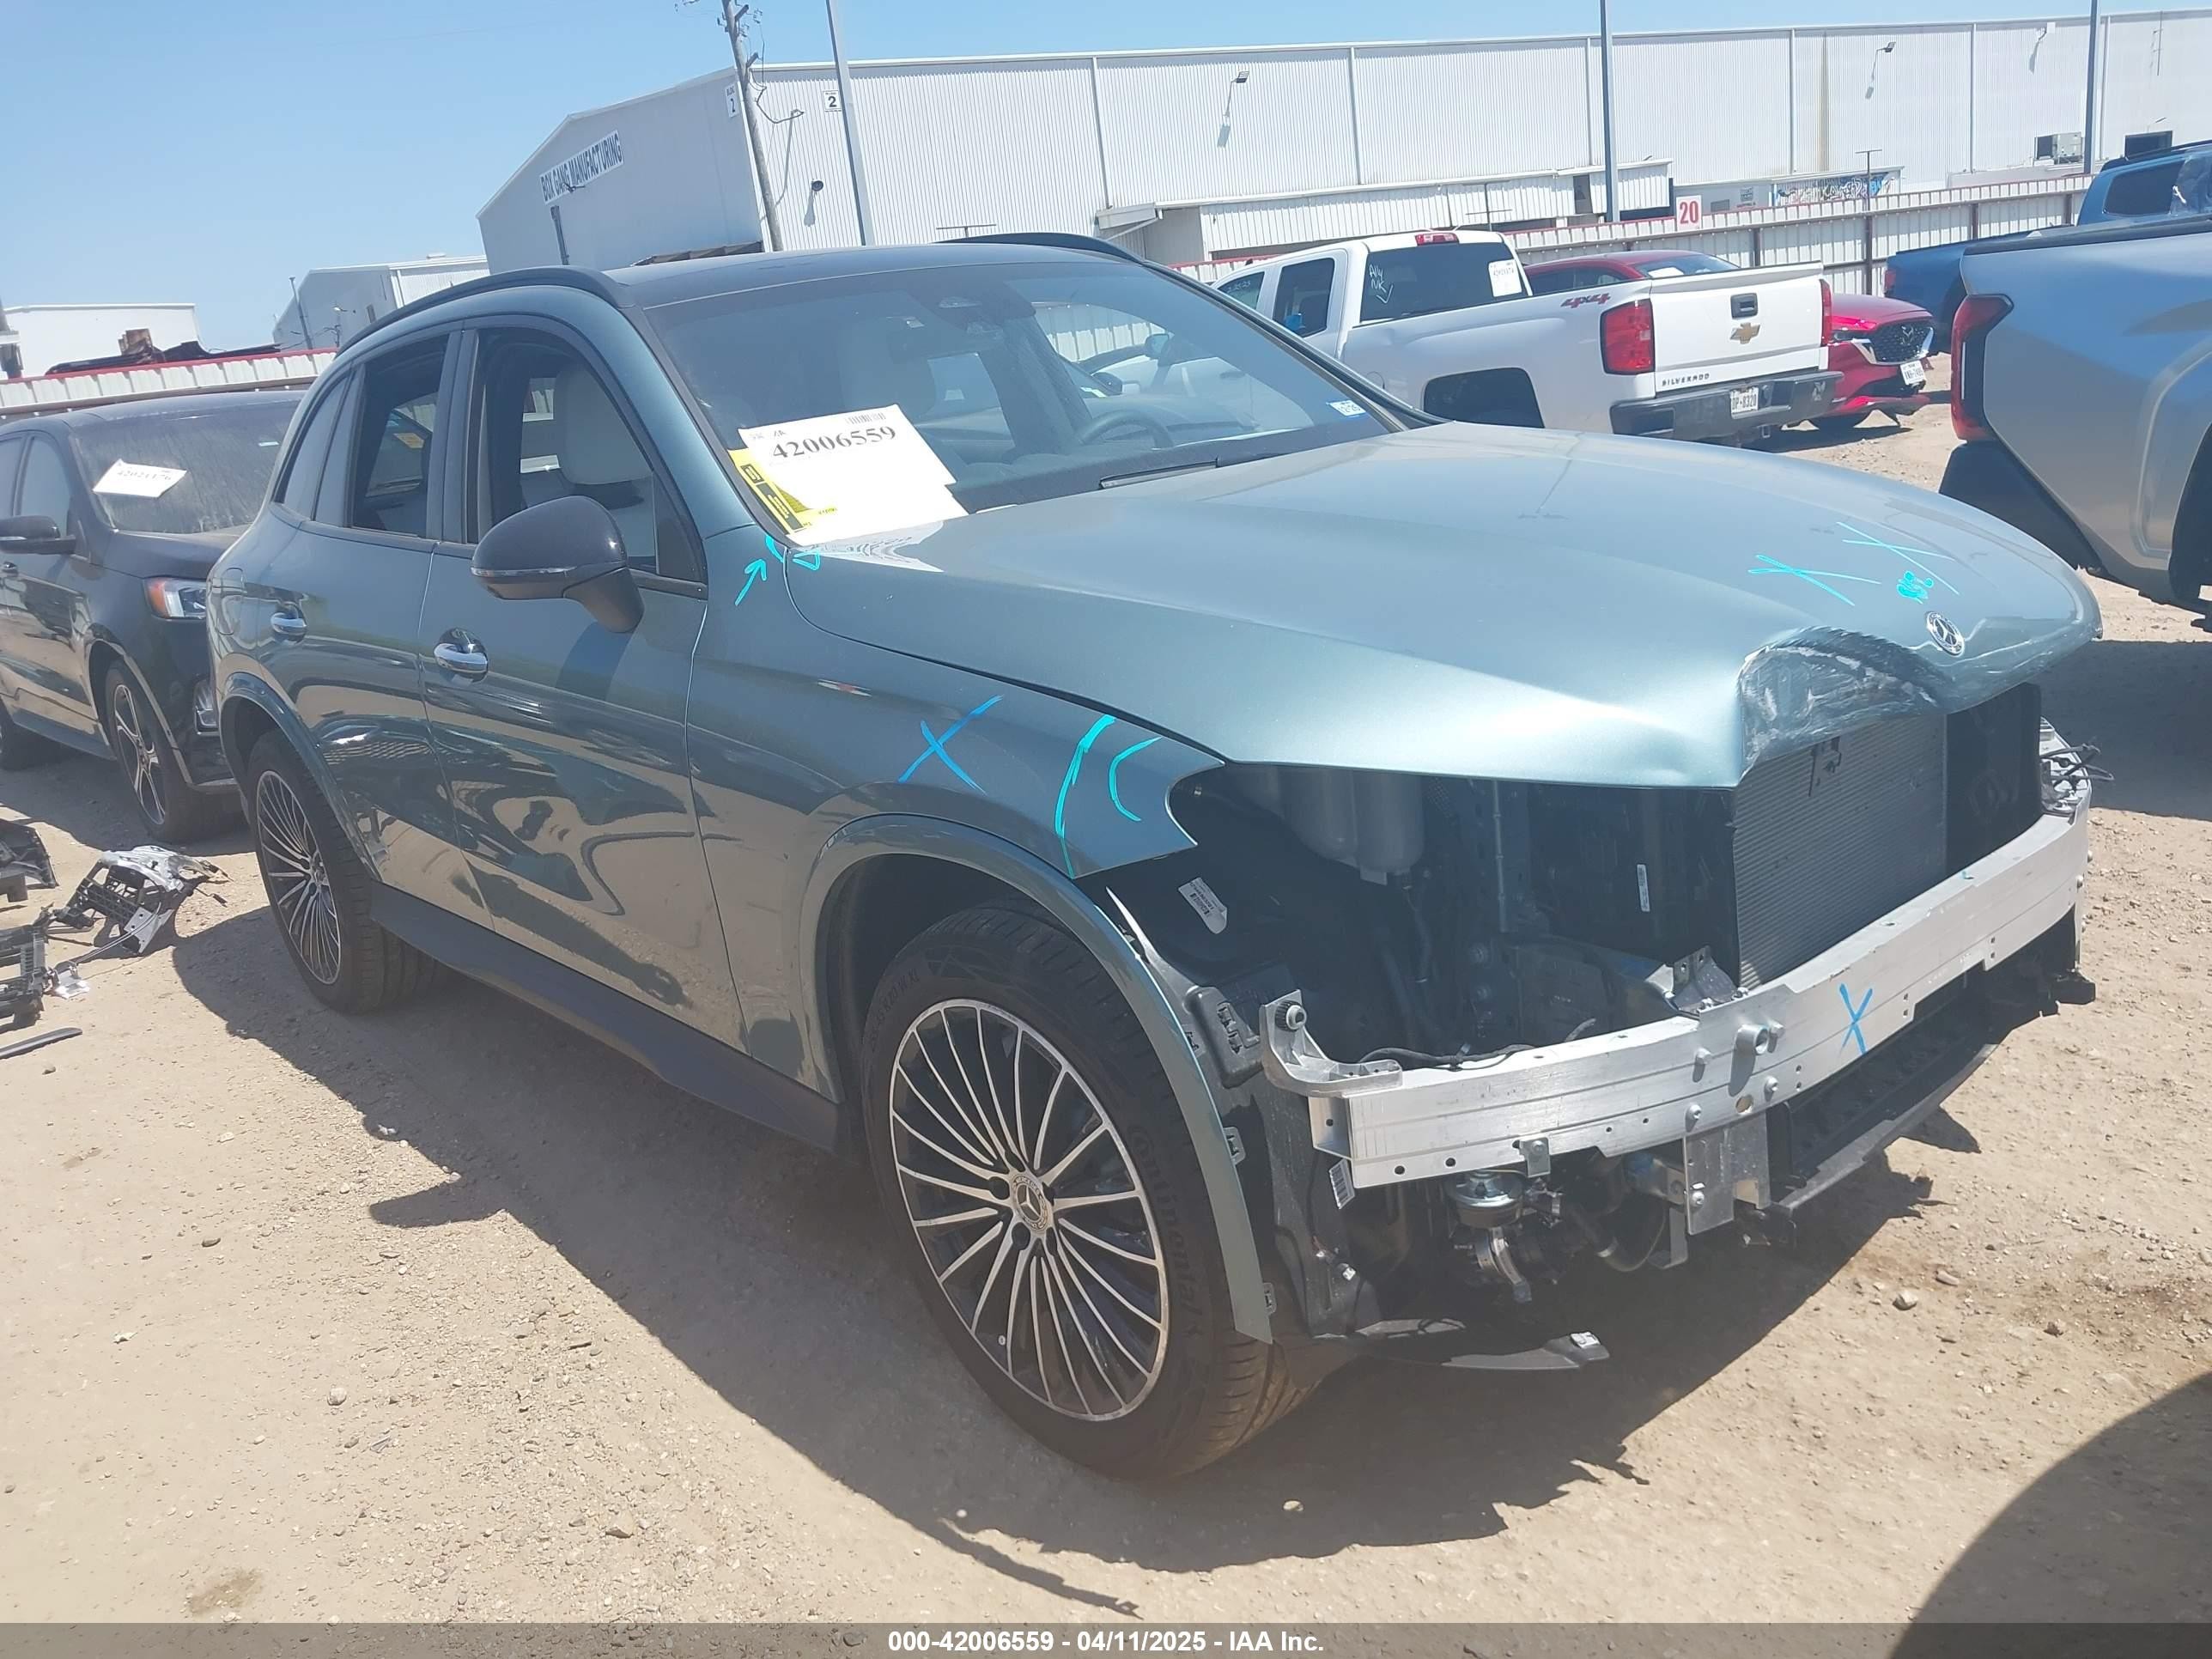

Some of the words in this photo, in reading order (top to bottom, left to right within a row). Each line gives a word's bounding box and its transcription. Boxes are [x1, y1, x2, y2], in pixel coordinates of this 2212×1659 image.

[828, 96, 837, 107] 2
[568, 132, 623, 187] MANUFACTURING
[1679, 200, 1699, 225] 20
[1662, 372, 1711, 387] SILVERADO
[772, 425, 896, 459] 42006559
